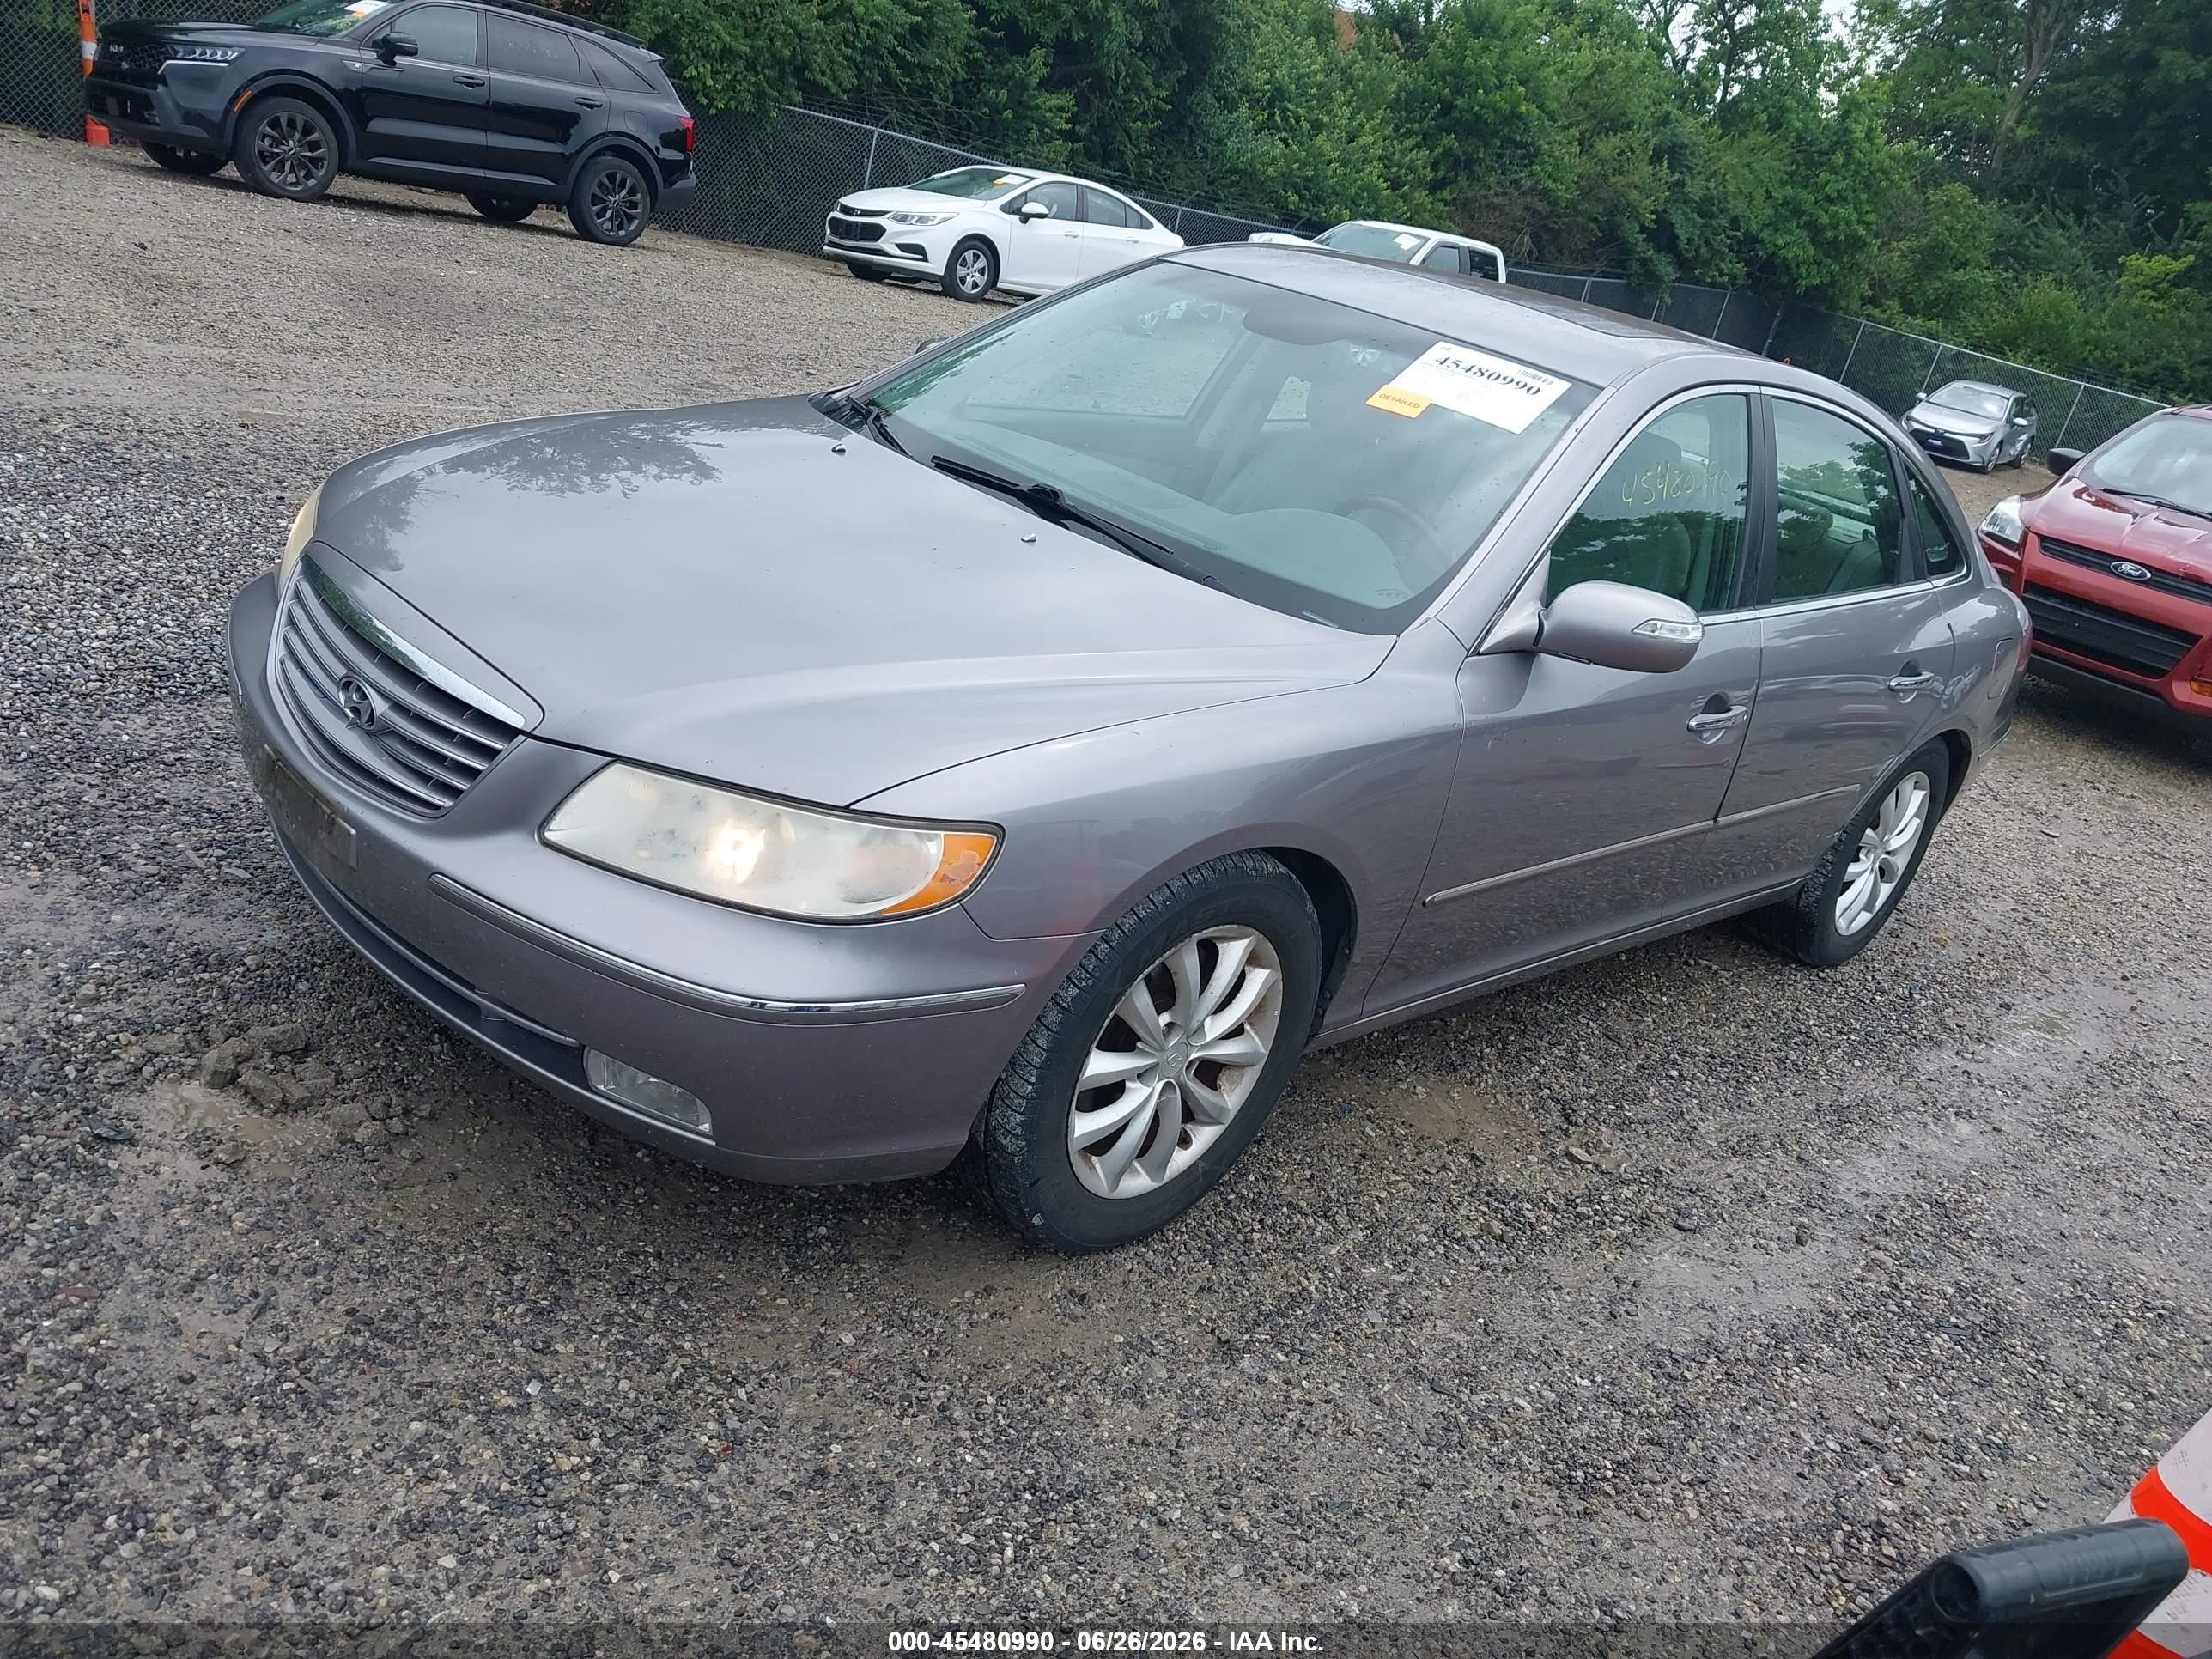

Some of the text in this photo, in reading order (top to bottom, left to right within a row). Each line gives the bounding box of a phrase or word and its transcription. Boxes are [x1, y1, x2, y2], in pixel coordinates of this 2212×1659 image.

[1435, 356, 1541, 396] 45480990
[1378, 393, 1421, 409] DETAILED
[2118, 563, 2142, 577] Ford
